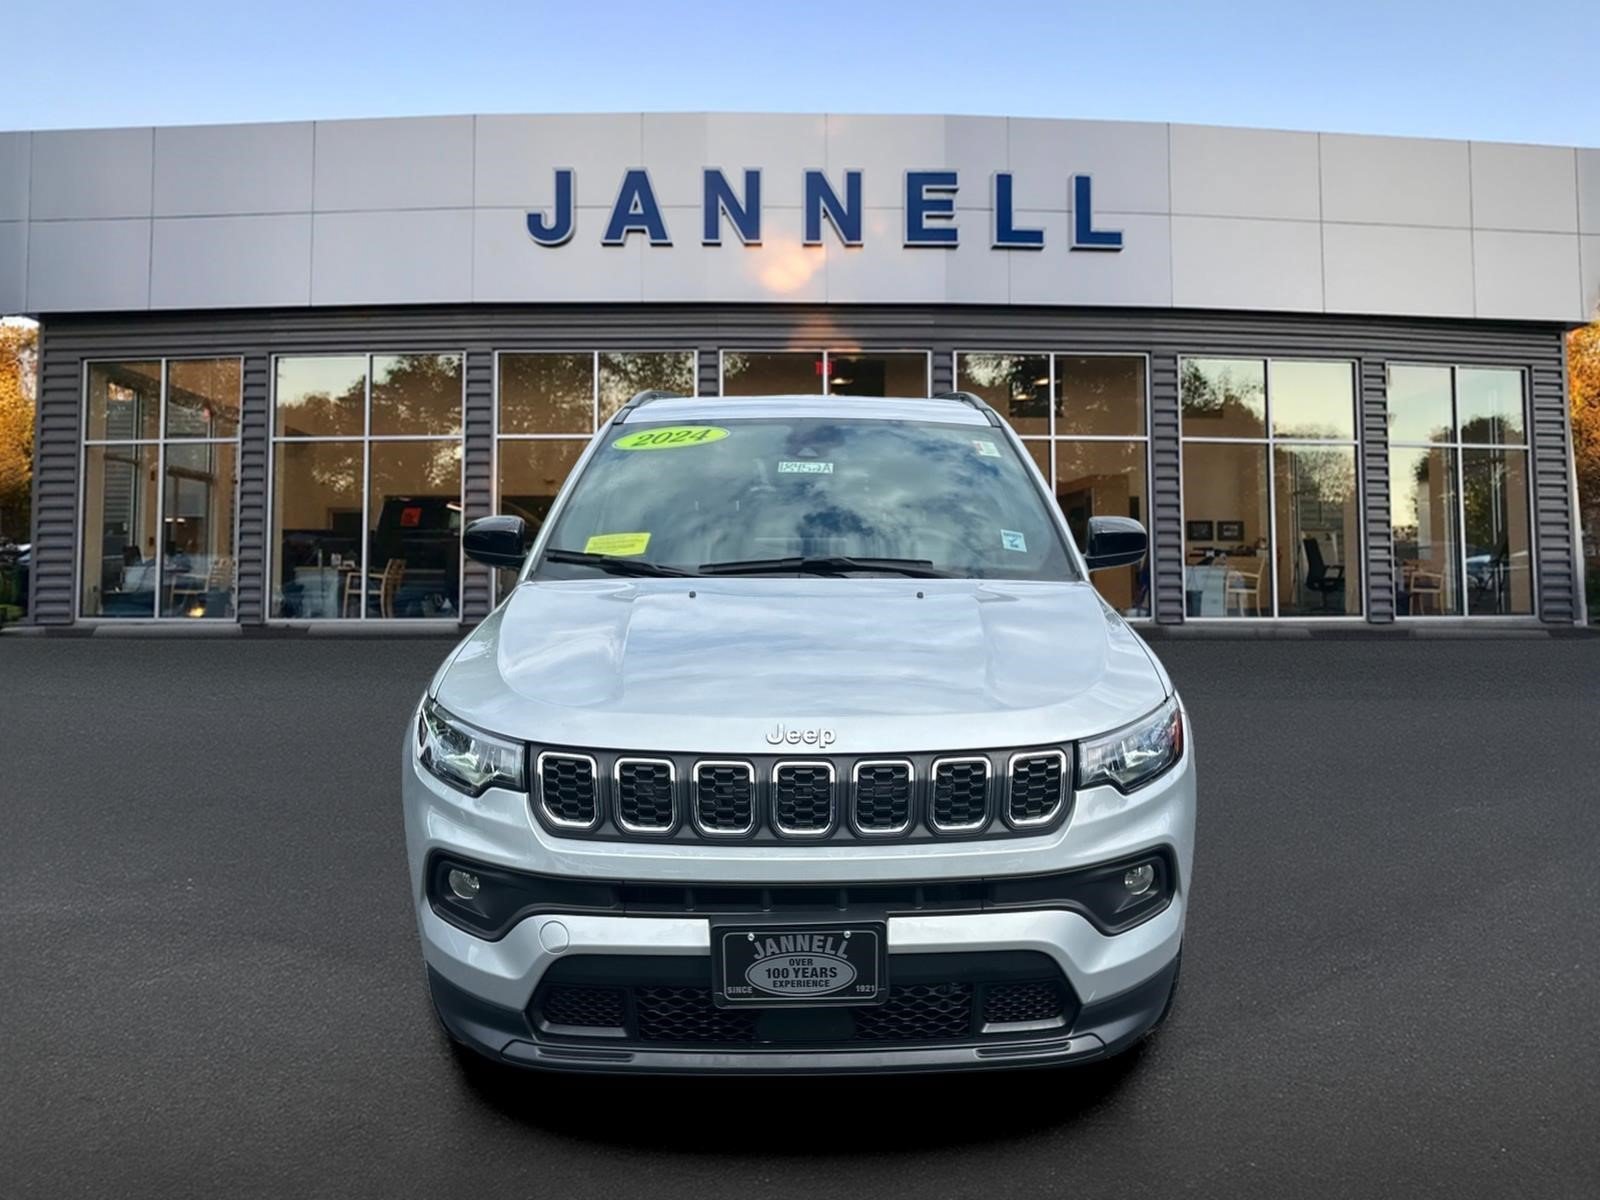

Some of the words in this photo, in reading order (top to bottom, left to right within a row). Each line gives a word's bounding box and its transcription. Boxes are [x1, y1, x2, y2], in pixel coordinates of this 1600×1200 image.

[526, 167, 1125, 250] JANNELL
[630, 428, 712, 448] 2024
[766, 722, 837, 749] Jeep
[753, 934, 849, 960] JANNELL
[788, 958, 813, 967] OVER
[765, 967, 789, 979] 100
[793, 966, 838, 979] YEARS
[727, 985, 753, 994] SINCE
[772, 979, 831, 988] EXPERIENCE
[855, 984, 875, 992] 1921
